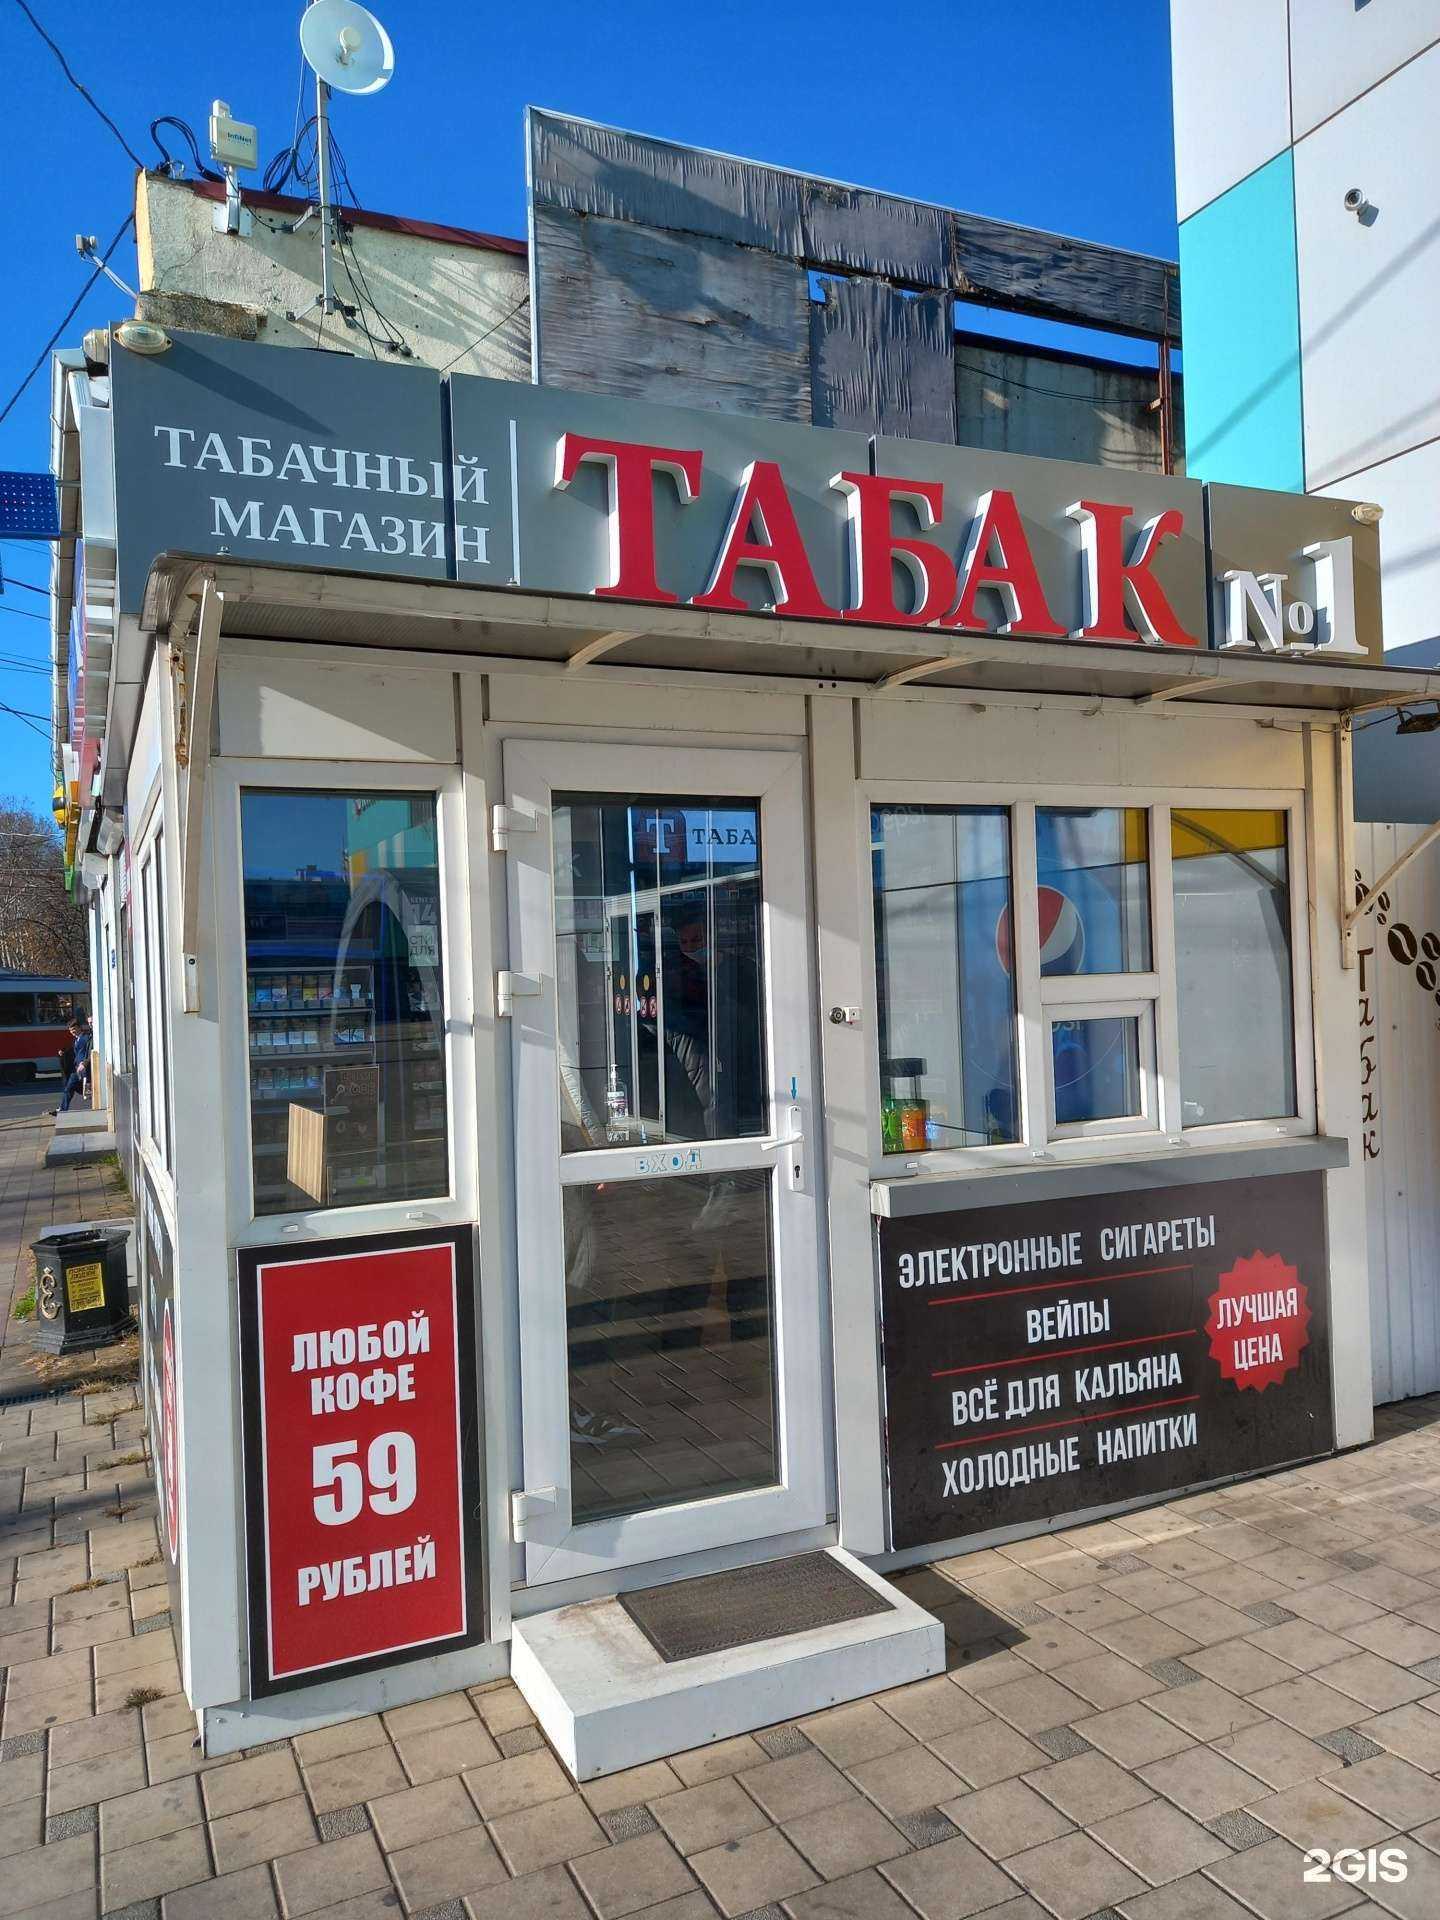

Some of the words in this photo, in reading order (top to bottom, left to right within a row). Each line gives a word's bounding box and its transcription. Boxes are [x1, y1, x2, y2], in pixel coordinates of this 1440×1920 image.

[153, 425, 490, 505] ТАБАЧНЫЙ
[210, 496, 490, 564] МАГАЗИН
[553, 431, 1199, 647] ТАБАК
[635, 1148, 704, 1174] ВХОД
[898, 1232, 1083, 1289] ЭЛЕКТРОННЫЕ
[1100, 1214, 1217, 1262] СИГАРЕТЫ
[291, 1309, 430, 1373] ЛЮБОЙ
[1026, 1298, 1110, 1344] ВЕЙПЫ
[1216, 1287, 1298, 1330] ЛУЧШАЯ
[1233, 1333, 1284, 1371] ЦЕНА
[310, 1364, 416, 1416] КОФЕ
[951, 1380, 999, 1426] ВСЁ
[1005, 1373, 1061, 1420] ДЛЯ
[1075, 1352, 1182, 1402] КАЛЬЯНА
[312, 1431, 417, 1526] 59
[941, 1436, 1081, 1498] ХОЛОДНЫЕ
[1097, 1413, 1198, 1465] НАПИТКИ
[297, 1534, 436, 1607] РУБЛЕЙ
